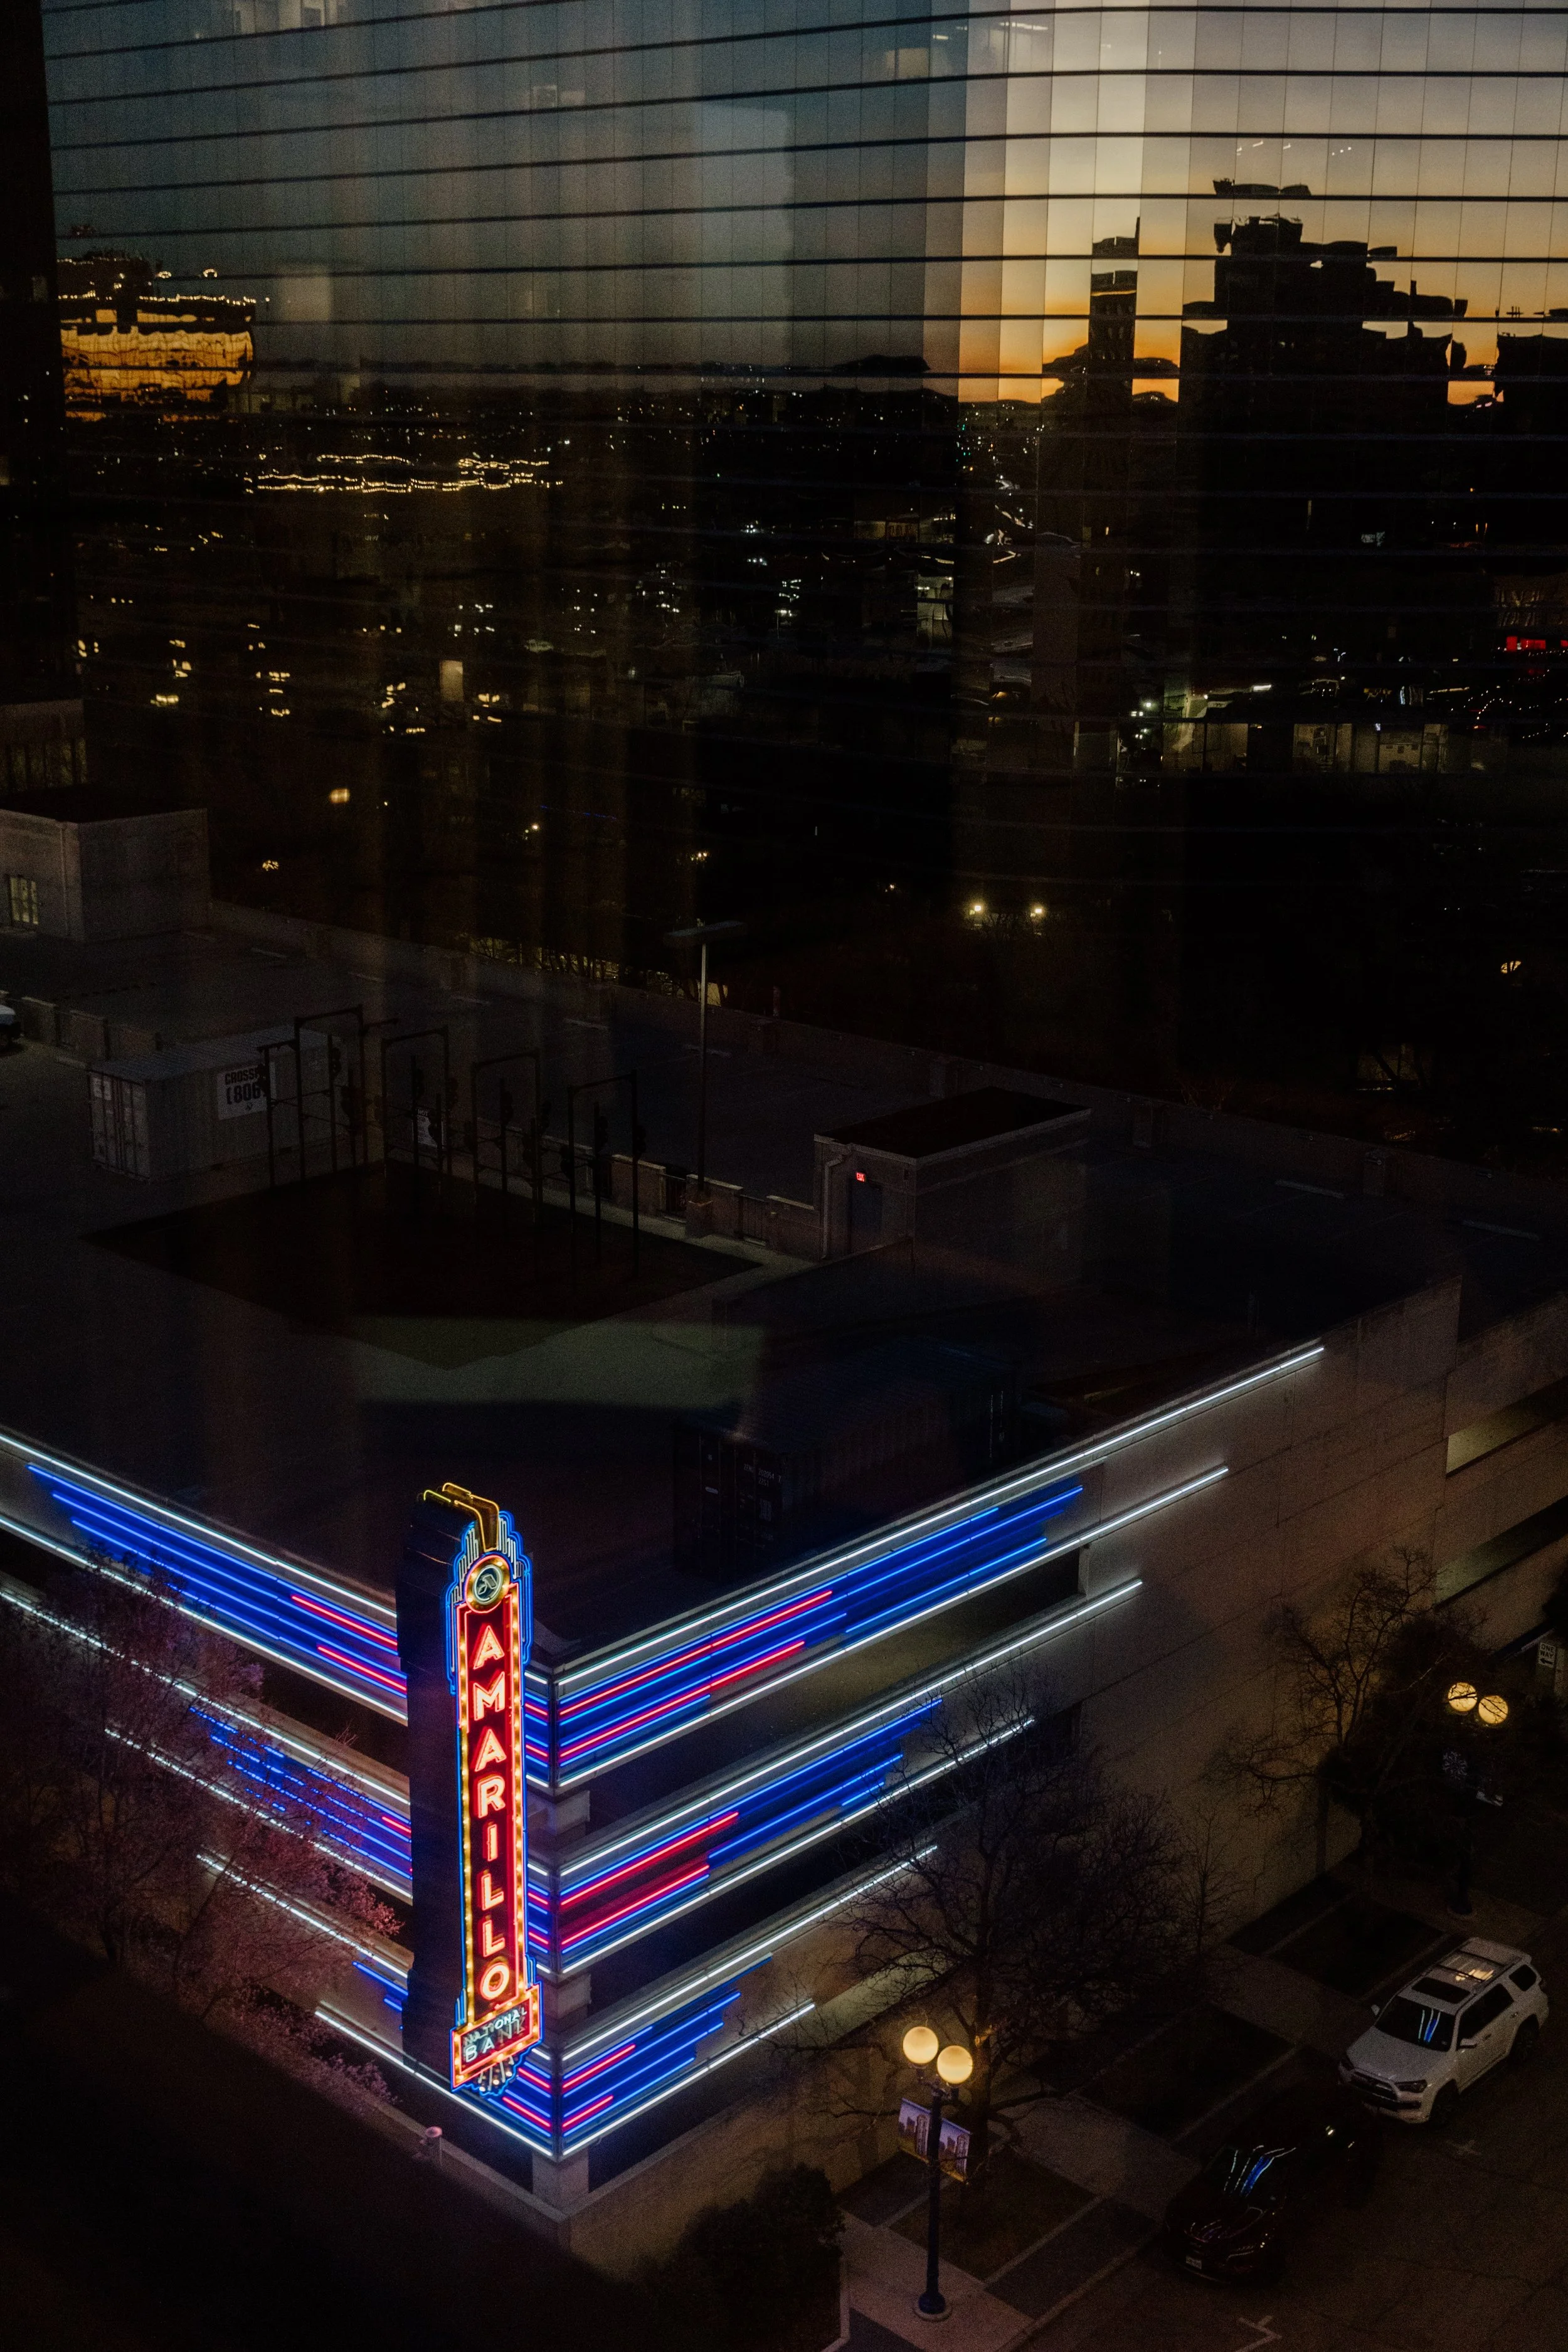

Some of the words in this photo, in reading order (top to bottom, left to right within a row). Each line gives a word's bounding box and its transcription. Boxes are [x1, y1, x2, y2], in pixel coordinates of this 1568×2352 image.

[1540, 1650, 1554, 1659] WAY
[1541, 1644, 1555, 1653] ONE
[472, 1624, 510, 2001] AMARILLO
[464, 2006, 527, 2045] NATIONAL
[464, 2016, 527, 2063] BANK
